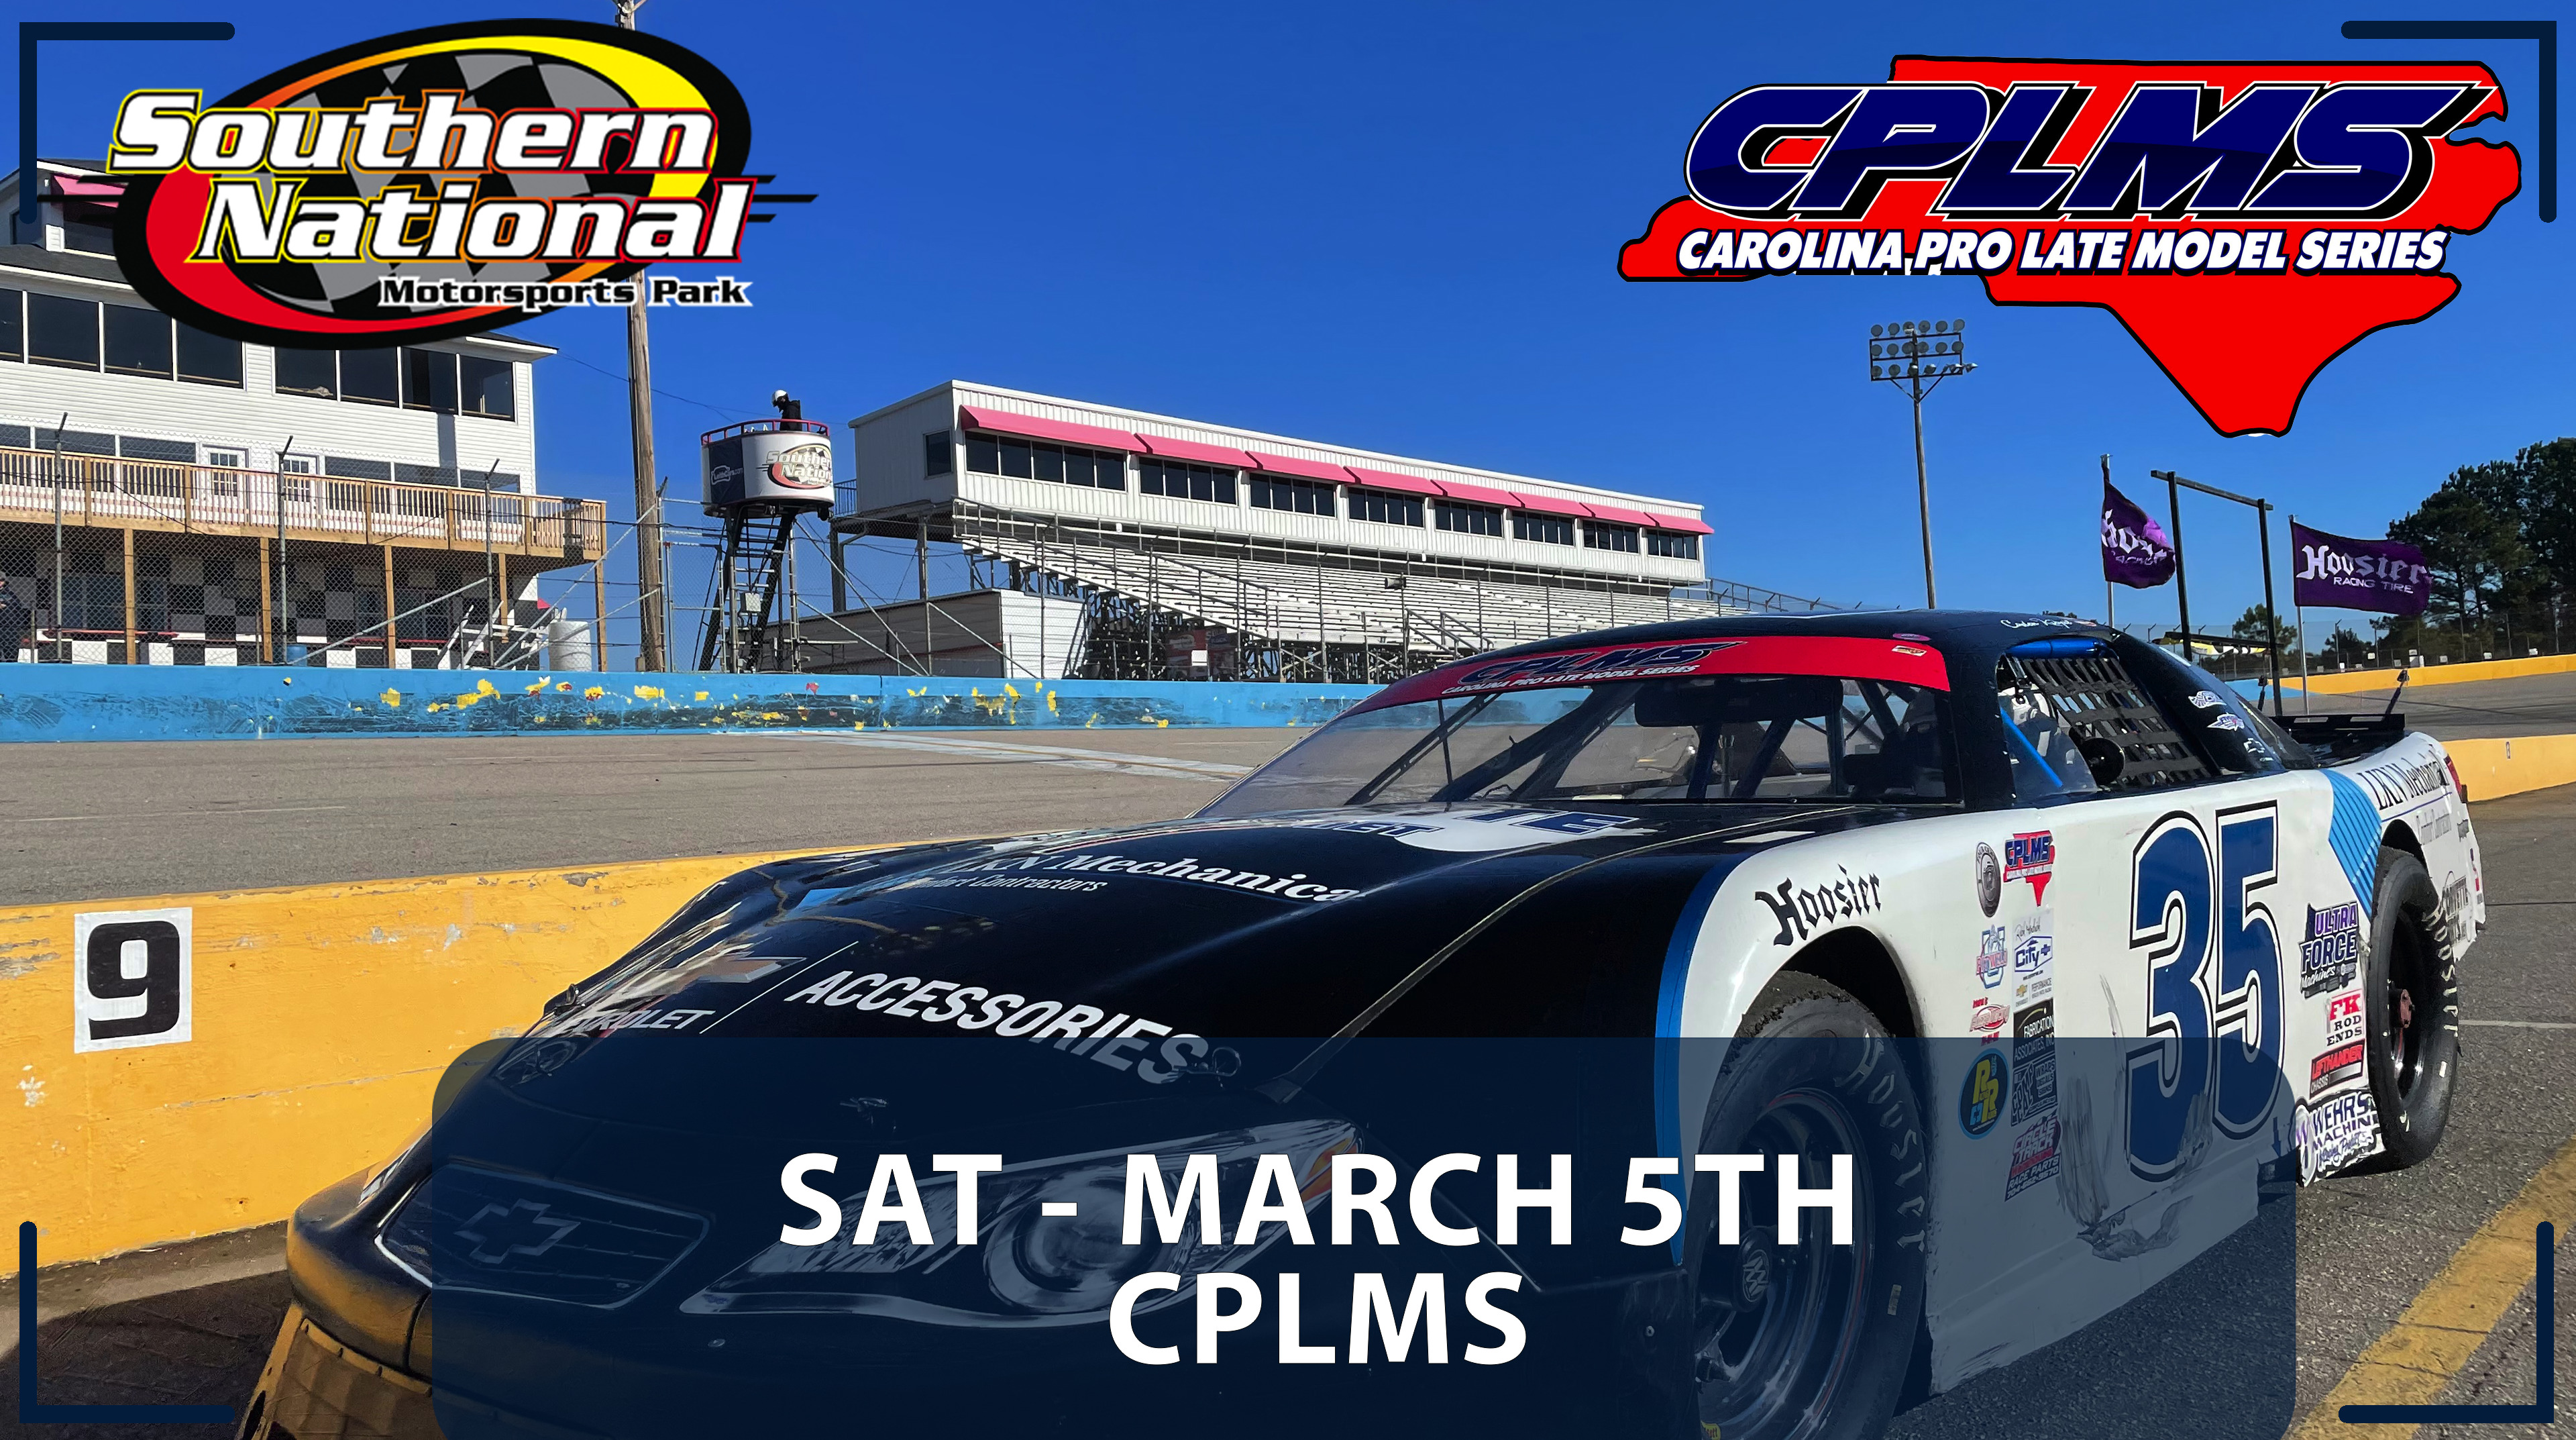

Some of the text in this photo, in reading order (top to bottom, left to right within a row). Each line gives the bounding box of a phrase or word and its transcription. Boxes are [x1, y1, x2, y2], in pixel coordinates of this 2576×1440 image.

[2296, 545, 2428, 584] Hoosier
[2381, 581, 2414, 594] TIRE
[1458, 641, 1748, 684] CPLMS
[1442, 664, 1701, 695] CAROLINA PRO LATE MODEL SERIES
[2005, 835, 2051, 867] CPLMS
[966, 874, 1108, 892] Contractors
[1755, 864, 1882, 947] Hoosier
[2314, 903, 2358, 937] ULTRA
[2015, 945, 2040, 968] City
[2300, 929, 2357, 974] FORCE
[87, 920, 180, 1041] 9
[2125, 799, 2286, 1182] 35
[2330, 993, 2361, 1021] FK
[2334, 1015, 2362, 1031] ROD
[784, 970, 1208, 1084] ACCESSORIES
[2024, 1015, 2054, 1039] FABRICATION
[2326, 1026, 2363, 1047] ENDS
[2013, 1118, 2057, 1153] CIRCLE
[2017, 1134, 2053, 1164] TRACK
[2008, 1170, 2030, 1190] RACE
[2030, 1155, 2059, 1176] PARTS
